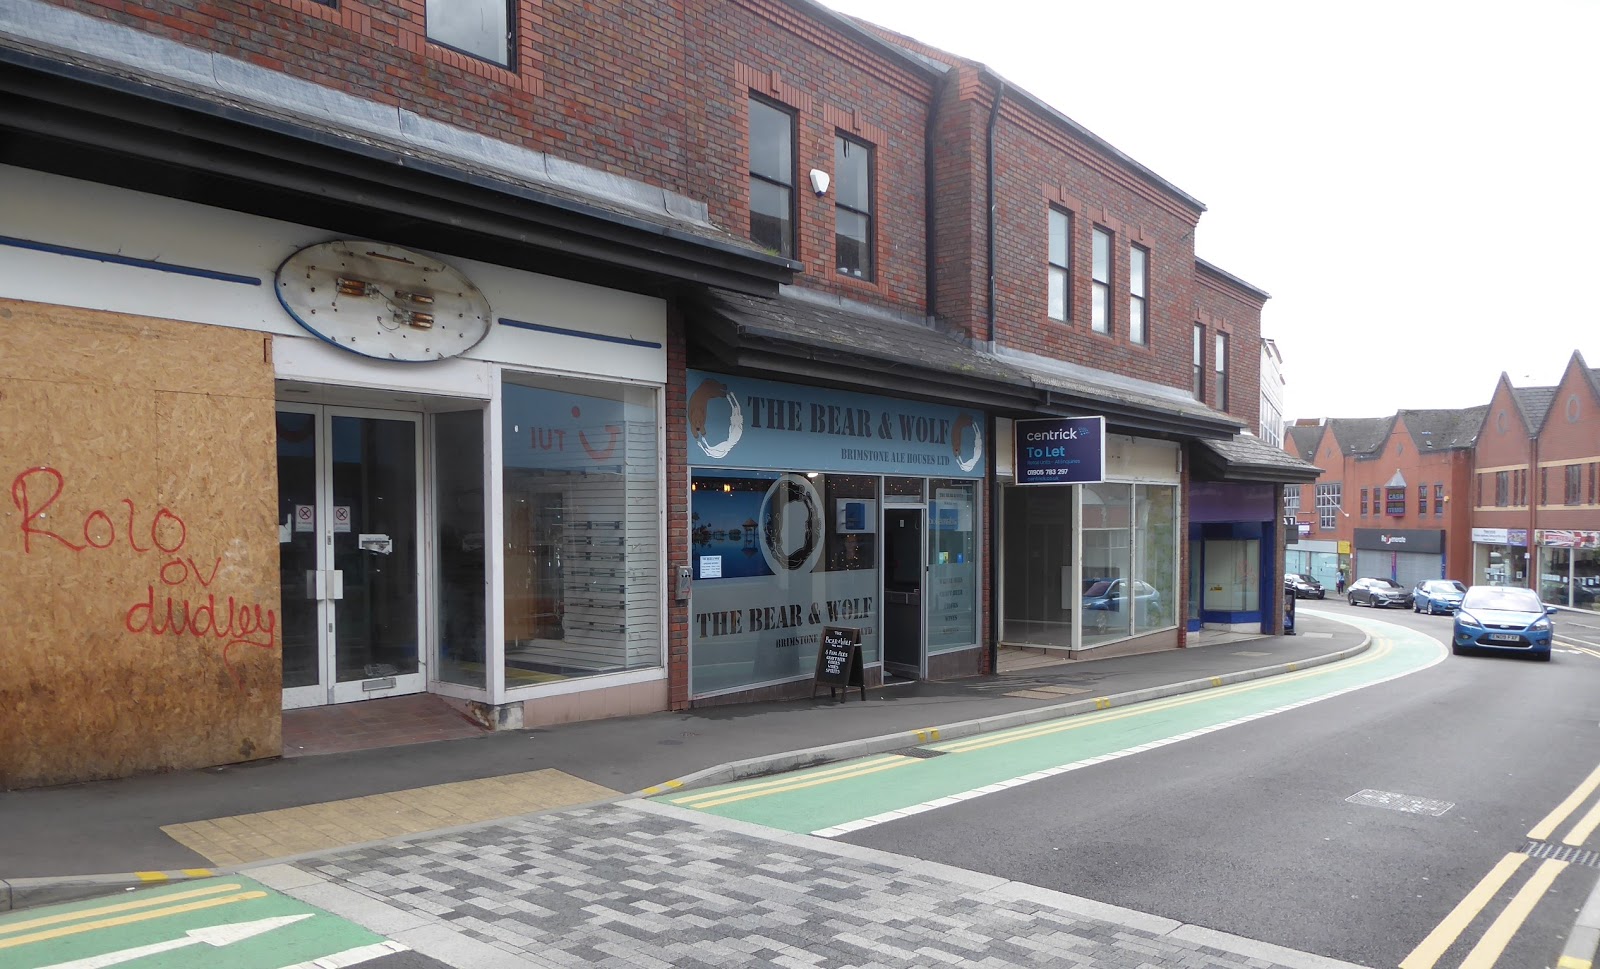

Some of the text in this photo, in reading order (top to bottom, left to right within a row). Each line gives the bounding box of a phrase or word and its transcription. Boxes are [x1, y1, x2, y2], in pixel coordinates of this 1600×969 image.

[748, 396, 950, 445] THE BEAR & WOLF
[1026, 427, 1078, 441] centrick
[841, 448, 950, 466] BRIMSTONE ALE HOUSES LTD
[1026, 446, 1066, 458] To Let
[12, 466, 187, 553] Rolo
[696, 597, 873, 638] THE BEAR & WOLF
[775, 634, 819, 649] BRIMSTONE
